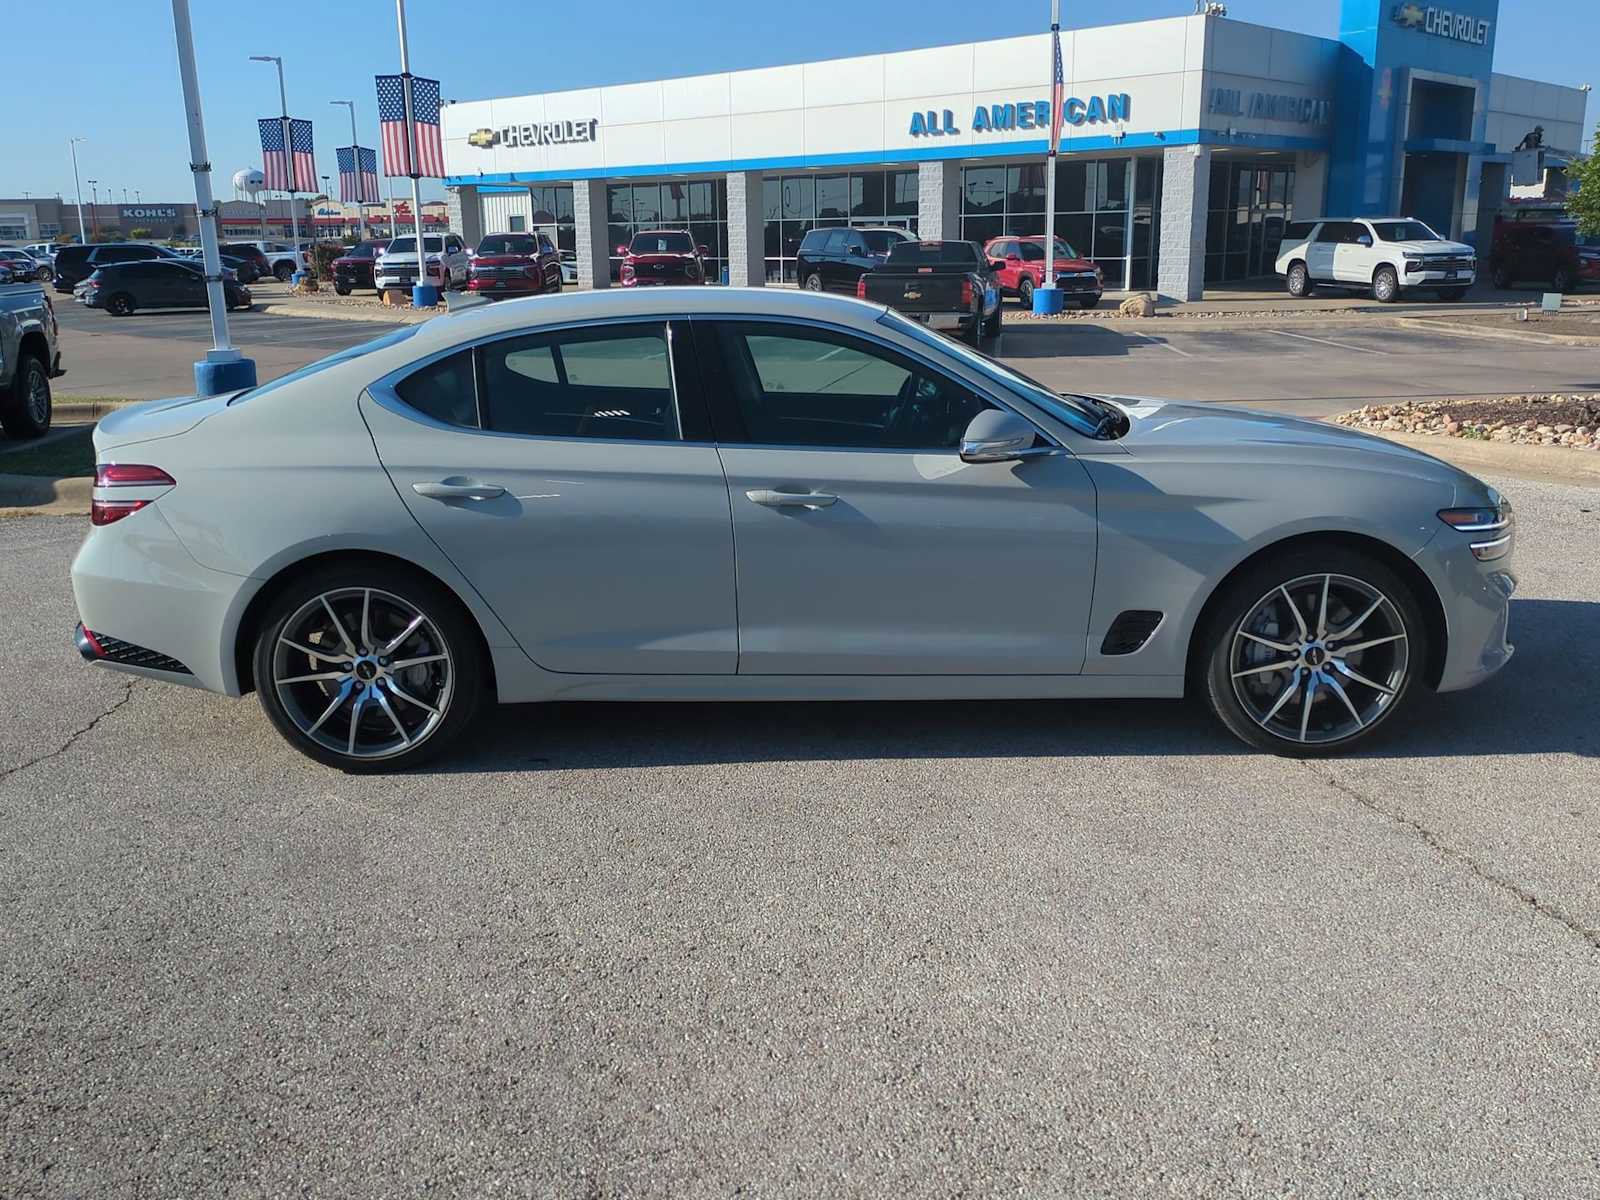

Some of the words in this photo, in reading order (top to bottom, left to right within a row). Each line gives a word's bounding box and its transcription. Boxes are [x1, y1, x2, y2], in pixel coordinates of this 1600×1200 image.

[1425, 6, 1490, 46] CHEVROLET
[500, 119, 598, 148] CHEVROLET
[909, 109, 960, 138] ALL
[972, 93, 1131, 132] AMERCAN
